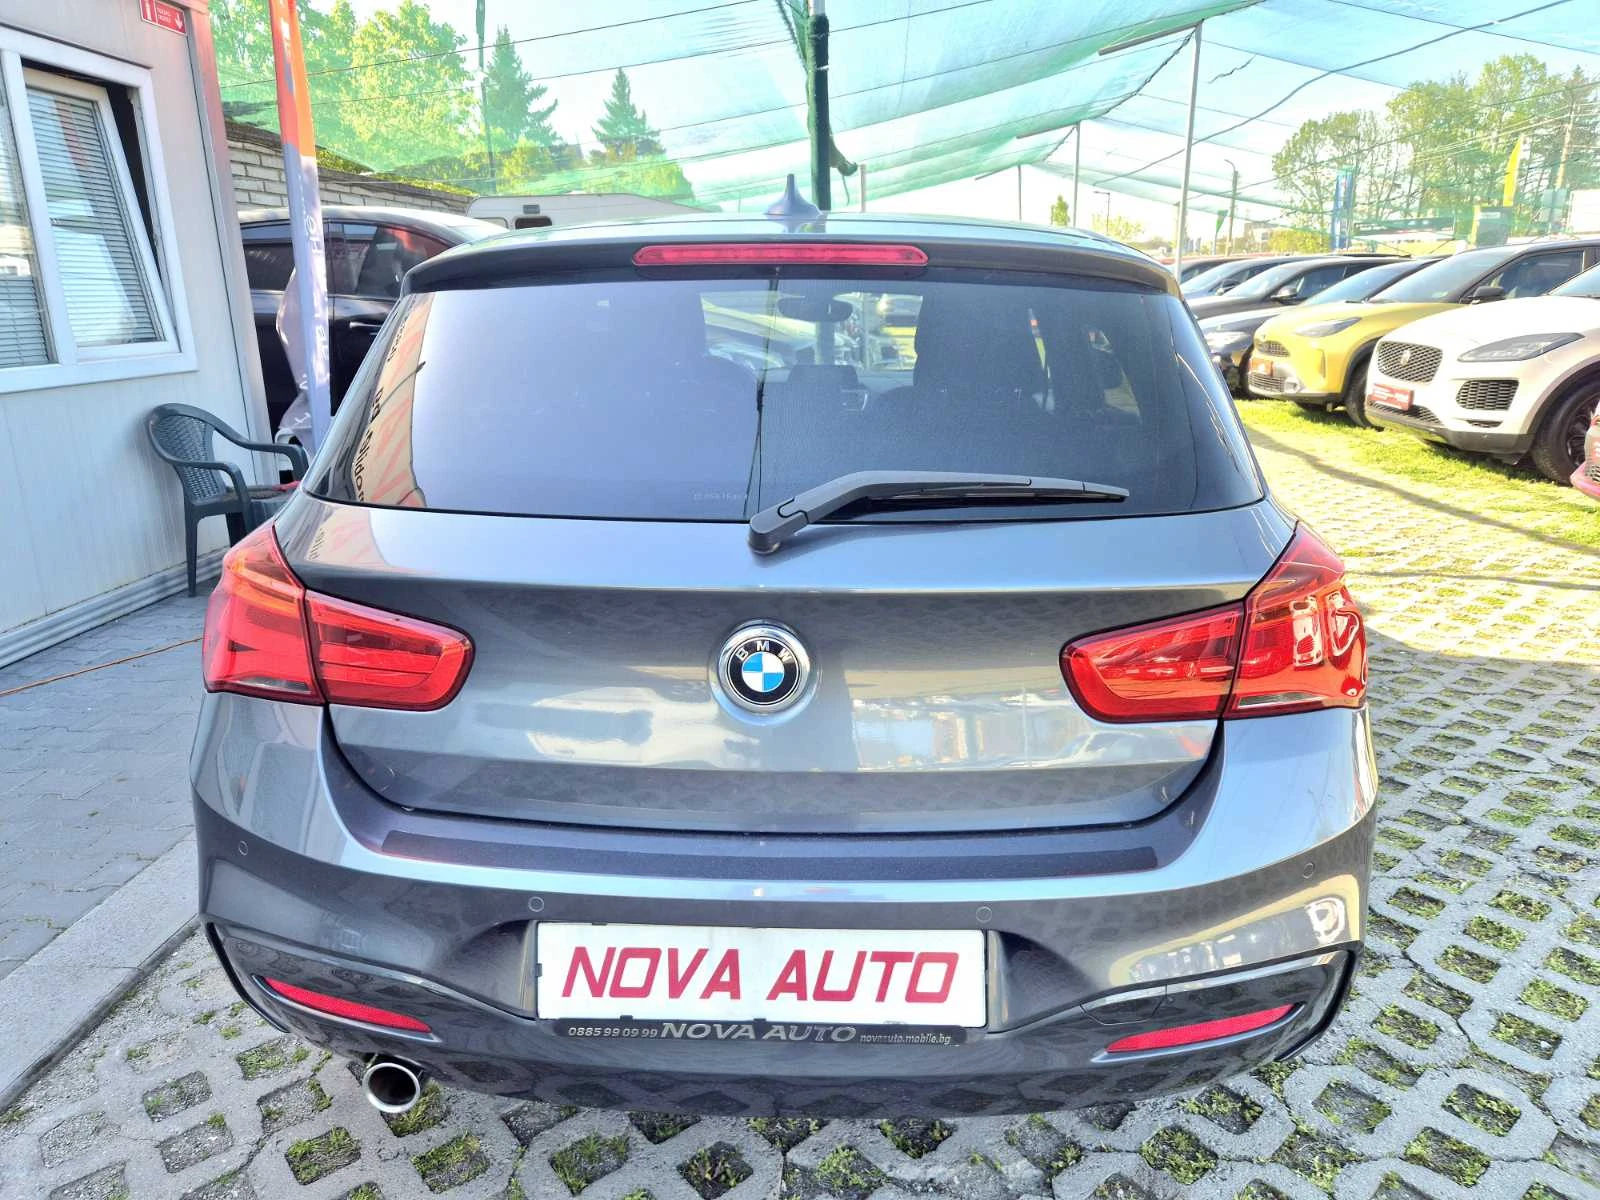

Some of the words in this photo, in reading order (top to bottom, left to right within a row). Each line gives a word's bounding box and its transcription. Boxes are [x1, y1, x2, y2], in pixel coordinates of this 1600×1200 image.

[735, 640, 793, 664] BMW
[562, 946, 741, 1000] NOVA
[766, 949, 959, 1003] AUTO
[568, 1026, 602, 1037] 0885
[603, 1027, 620, 1037] 99
[622, 1028, 639, 1038] 09
[641, 1028, 658, 1039] 99
[660, 1022, 756, 1040] NOVA
[762, 1024, 857, 1042] AUTO
